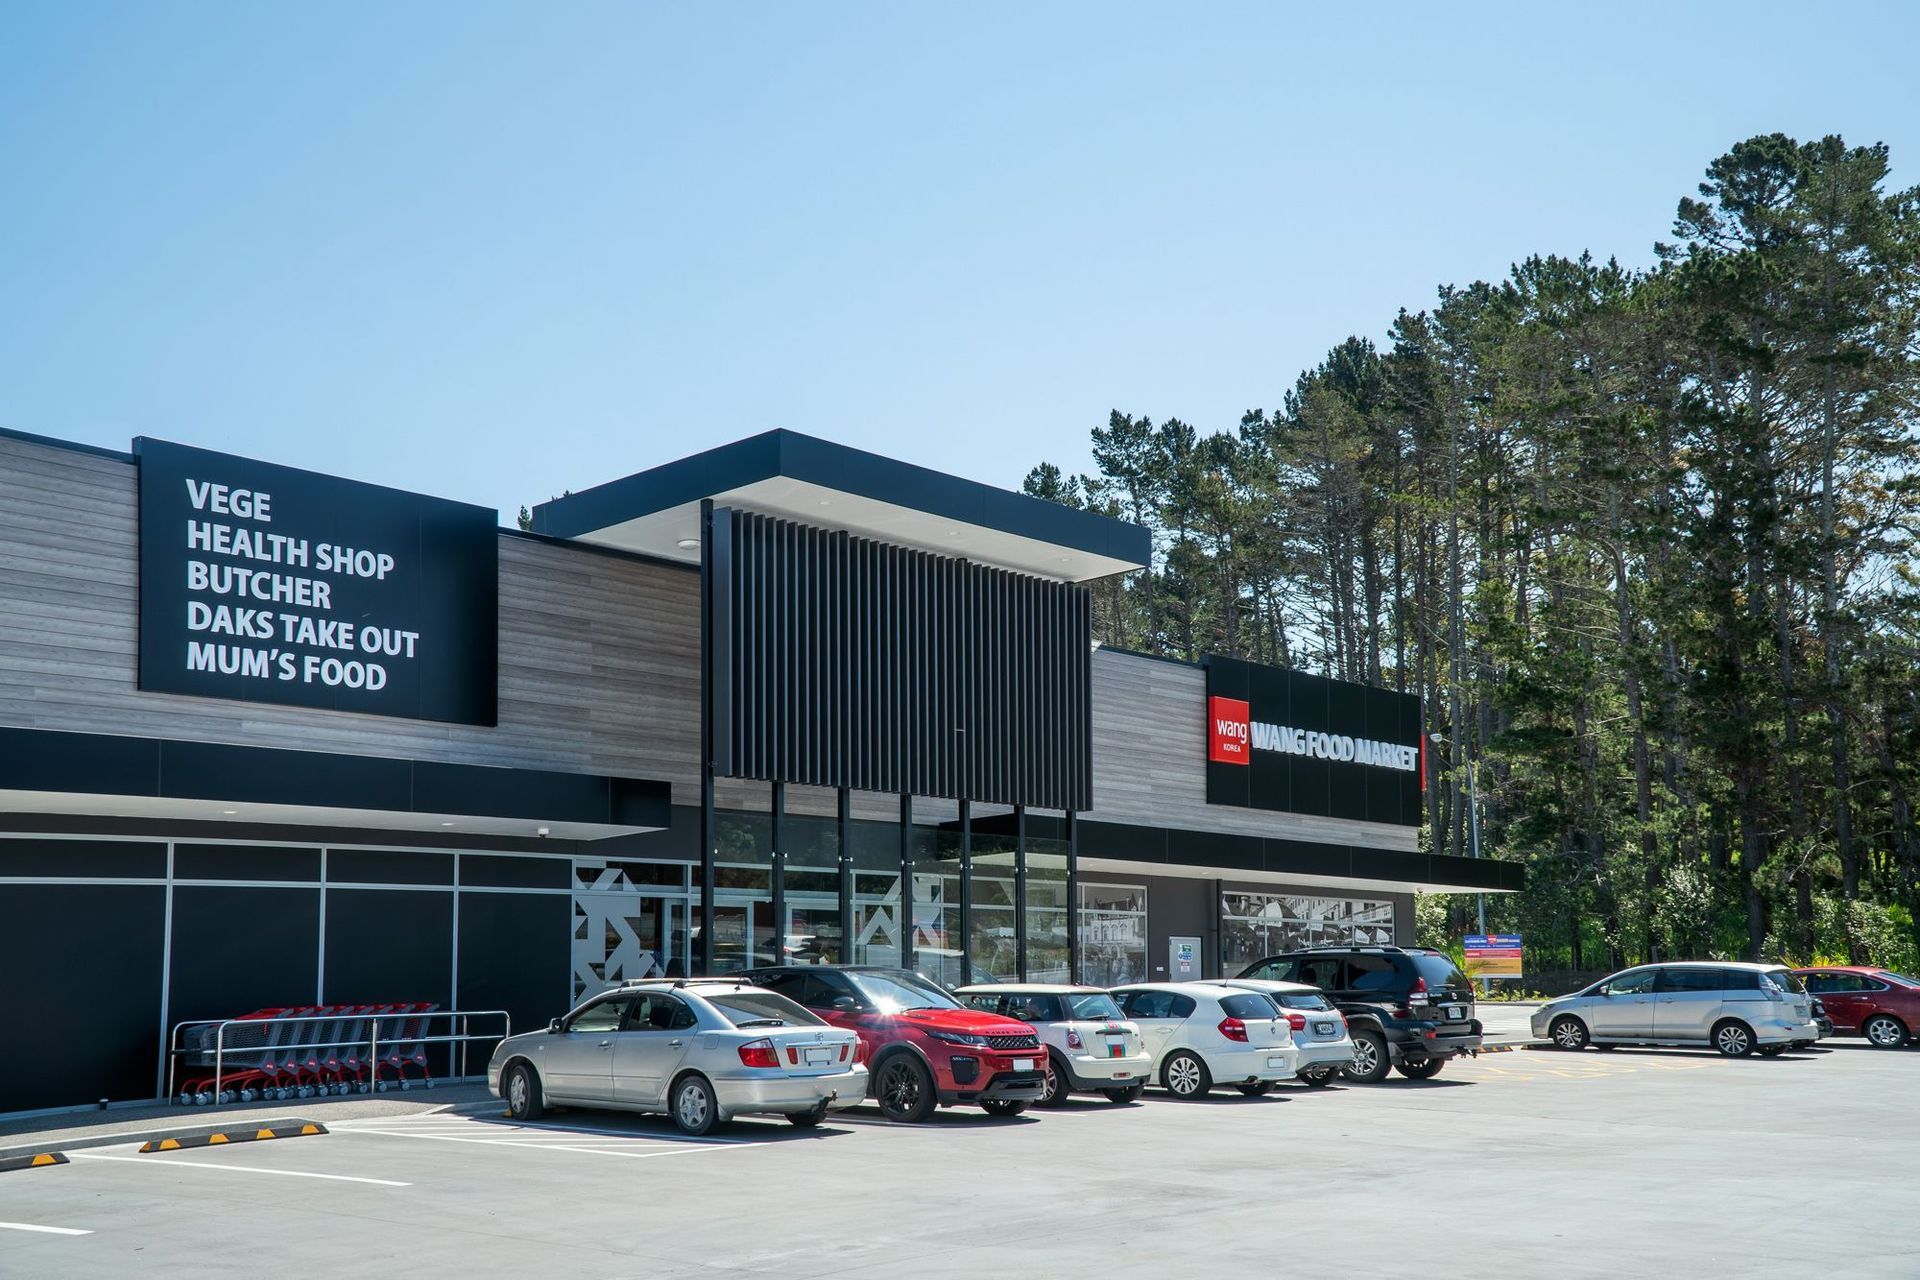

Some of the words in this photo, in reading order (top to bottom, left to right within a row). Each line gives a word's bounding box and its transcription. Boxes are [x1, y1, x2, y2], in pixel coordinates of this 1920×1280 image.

[185, 479, 272, 522] VEGE
[187, 520, 308, 568] HEALTH
[315, 543, 395, 580] SHOP
[187, 560, 331, 610] BUTCHER
[187, 601, 275, 640] DAKS
[279, 614, 355, 651] TAKE
[359, 626, 420, 658] OUT
[186, 642, 297, 681] MUM'S
[303, 656, 387, 691] FOOD
[1217, 719, 1247, 744] wang
[1223, 743, 1242, 753] KOREA
[1250, 721, 1305, 755] WANG
[1306, 731, 1355, 762] FOOD
[1354, 738, 1419, 772] MARKET
